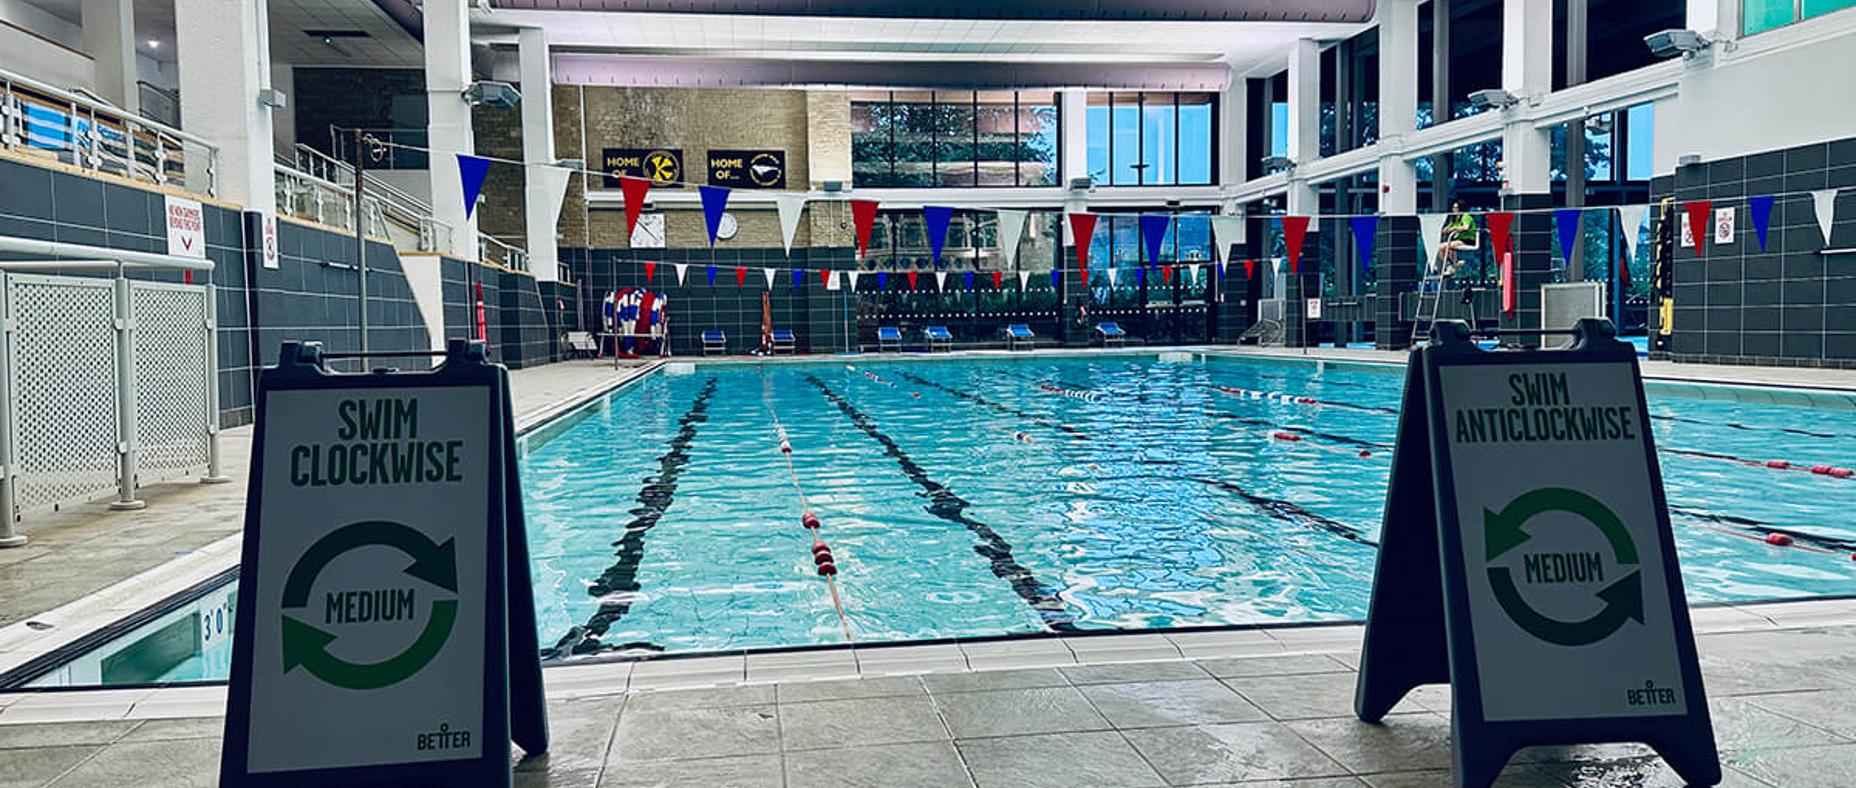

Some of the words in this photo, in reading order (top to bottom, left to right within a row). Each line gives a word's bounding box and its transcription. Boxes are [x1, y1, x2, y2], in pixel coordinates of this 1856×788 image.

[607, 157, 640, 167] HOME
[711, 159, 743, 169] HOME
[1510, 373, 1569, 406] SWIM
[338, 399, 417, 440] SWIM
[1456, 407, 1635, 443] ANTICLOCKWISE
[290, 441, 462, 486] CLOCKWISE
[1524, 552, 1603, 583] MEDIUM
[325, 589, 415, 624] MEDIUM
[1627, 682, 1675, 705] BETTER
[417, 726, 470, 750] BETTER
